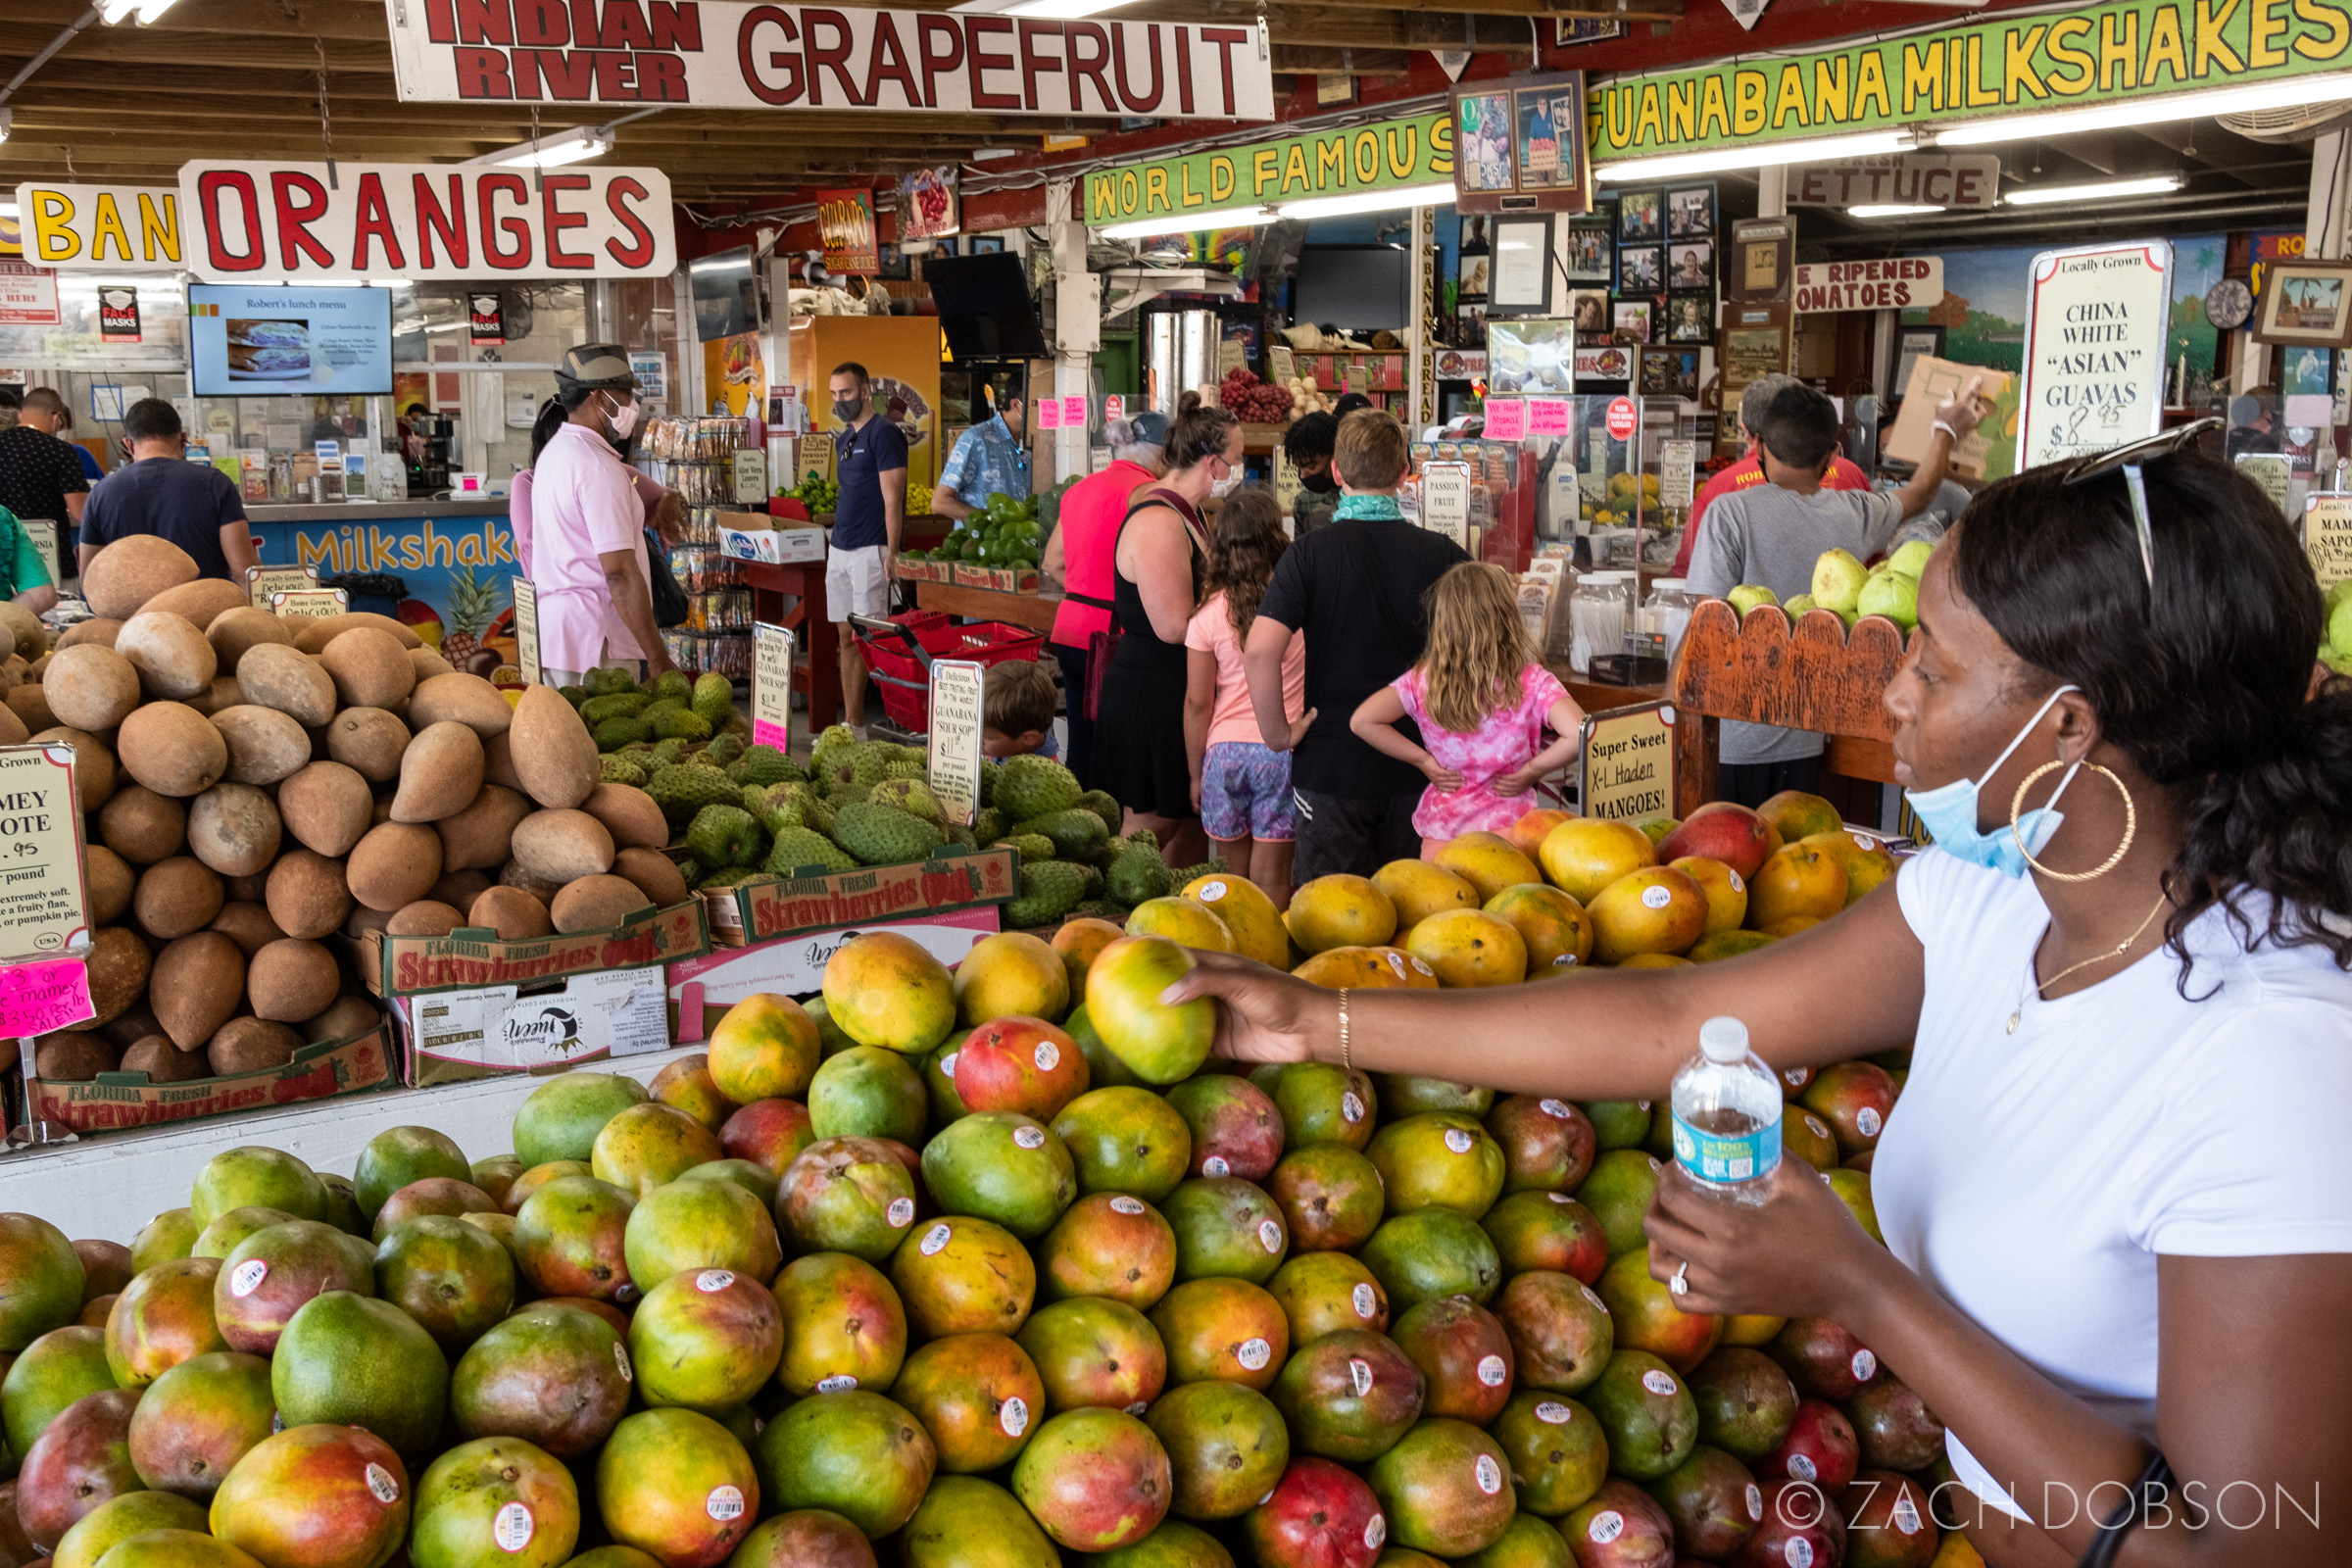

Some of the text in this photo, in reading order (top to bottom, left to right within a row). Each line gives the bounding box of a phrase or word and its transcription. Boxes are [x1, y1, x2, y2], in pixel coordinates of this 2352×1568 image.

[428, 0, 704, 52] INDIAN
[737, 5, 1248, 116] GRAPEFRUIT
[1903, 0, 2351, 114] MILKSHAKES
[453, 46, 690, 103] RIVER
[1093, 117, 1454, 220] WORLD FAMOUS
[1786, 168, 1984, 204] ETTUCE
[198, 170, 656, 271] ORANGES
[1423, 247, 1434, 257] &
[825, 255, 877, 270] SUGAR CANE JUICE
[1829, 260, 1931, 283] RIPENED
[2062, 256, 2141, 274] Locally Grown
[6, 294, 38, 303] HERE
[247, 298, 346, 310] Robert's lunch menu
[1795, 281, 1912, 311] OMATOES
[103, 308, 135, 318] FACE
[1422, 264, 1434, 347] BANANA
[2066, 302, 2128, 322] CHINA
[104, 318, 136, 327] MASKS
[472, 314, 500, 323] FACE
[472, 322, 501, 331] MASKS
[2063, 323, 2128, 344] WHITE
[1575, 356, 1597, 371] IES
[1419, 354, 1433, 424] BREAD
[2046, 382, 2137, 408] GUAVAS
[738, 466, 762, 474] Aloe Vera
[1736, 470, 1765, 485] ROB
[1430, 482, 1460, 491] PASSION
[1434, 497, 1456, 507] FRUIT
[2320, 502, 2347, 513] Locally
[262, 573, 305, 584] Locally Grown
[2330, 567, 2342, 576] Eat
[291, 599, 332, 608] Home Grown
[946, 671, 970, 683] Delicious
[769, 711, 781, 720] pound
[935, 705, 977, 722] GUANABANA
[1592, 730, 1666, 760] Super Sweet
[0, 757, 41, 769] Grown
[942, 761, 966, 772] per pound
[1595, 789, 1665, 819] MANGOES!
[1, 813, 51, 836] OTE
[6, 867, 45, 885] pound
[775, 872, 877, 900] FLORIDA FRESH
[0, 887, 72, 905] extremely soft.
[16, 901, 46, 916] fruity
[47, 901, 70, 911] flan,
[755, 877, 919, 938] Strawberries
[17, 911, 63, 928] pumpkin
[64, 910, 81, 921] pie.
[38, 937, 59, 946] USA
[424, 940, 552, 960] FLORIDA FRESH
[42, 969, 58, 983] or
[398, 945, 597, 992] Strawberries
[21, 981, 78, 1004] mamey
[630, 1037, 666, 1048] Exported by:
[68, 1084, 213, 1103] FLORIDA FRESH
[38, 1083, 267, 1132] Strawberries
[709, 1496, 744, 1505] MARATHON
